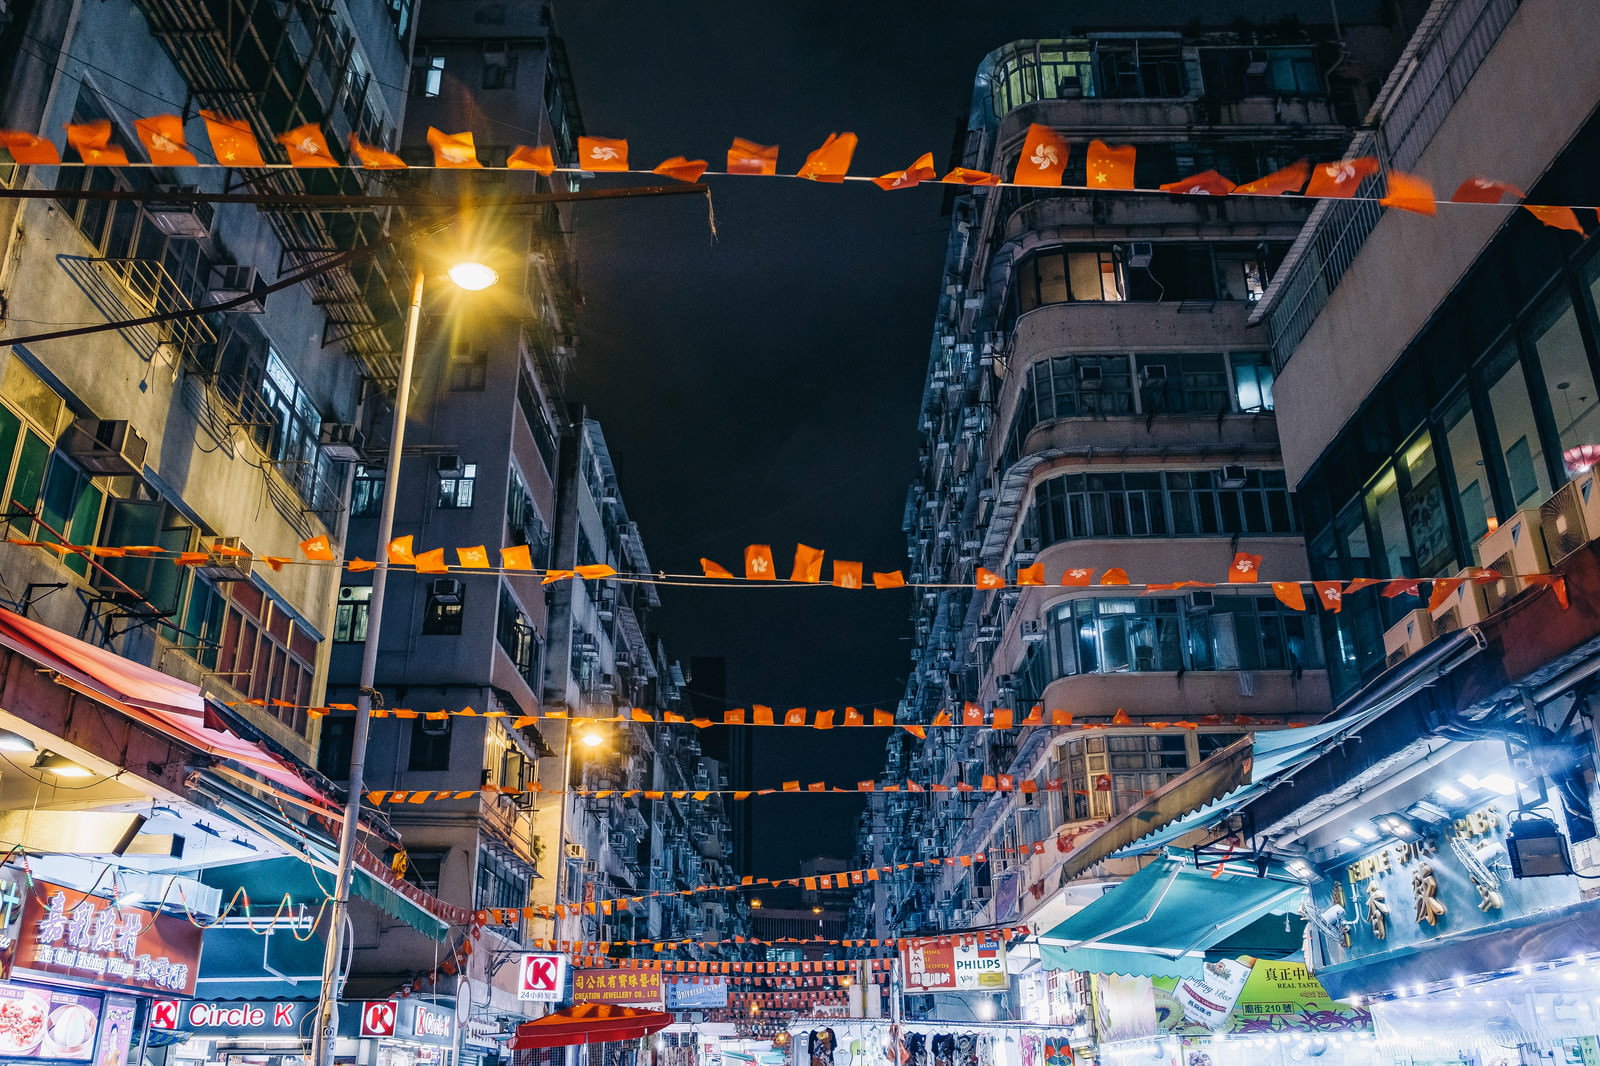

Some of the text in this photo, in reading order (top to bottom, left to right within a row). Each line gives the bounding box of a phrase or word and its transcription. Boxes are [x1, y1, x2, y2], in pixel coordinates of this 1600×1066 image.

[956, 959, 1001, 970] PHILIPS
[531, 960, 555, 989] K
[574, 992, 601, 1000] CREATION
[602, 991, 633, 999] JEWELLERY
[188, 1002, 295, 1026] Circle K
[1264, 1004, 1281, 1013] 210
[370, 1005, 395, 1033] K
